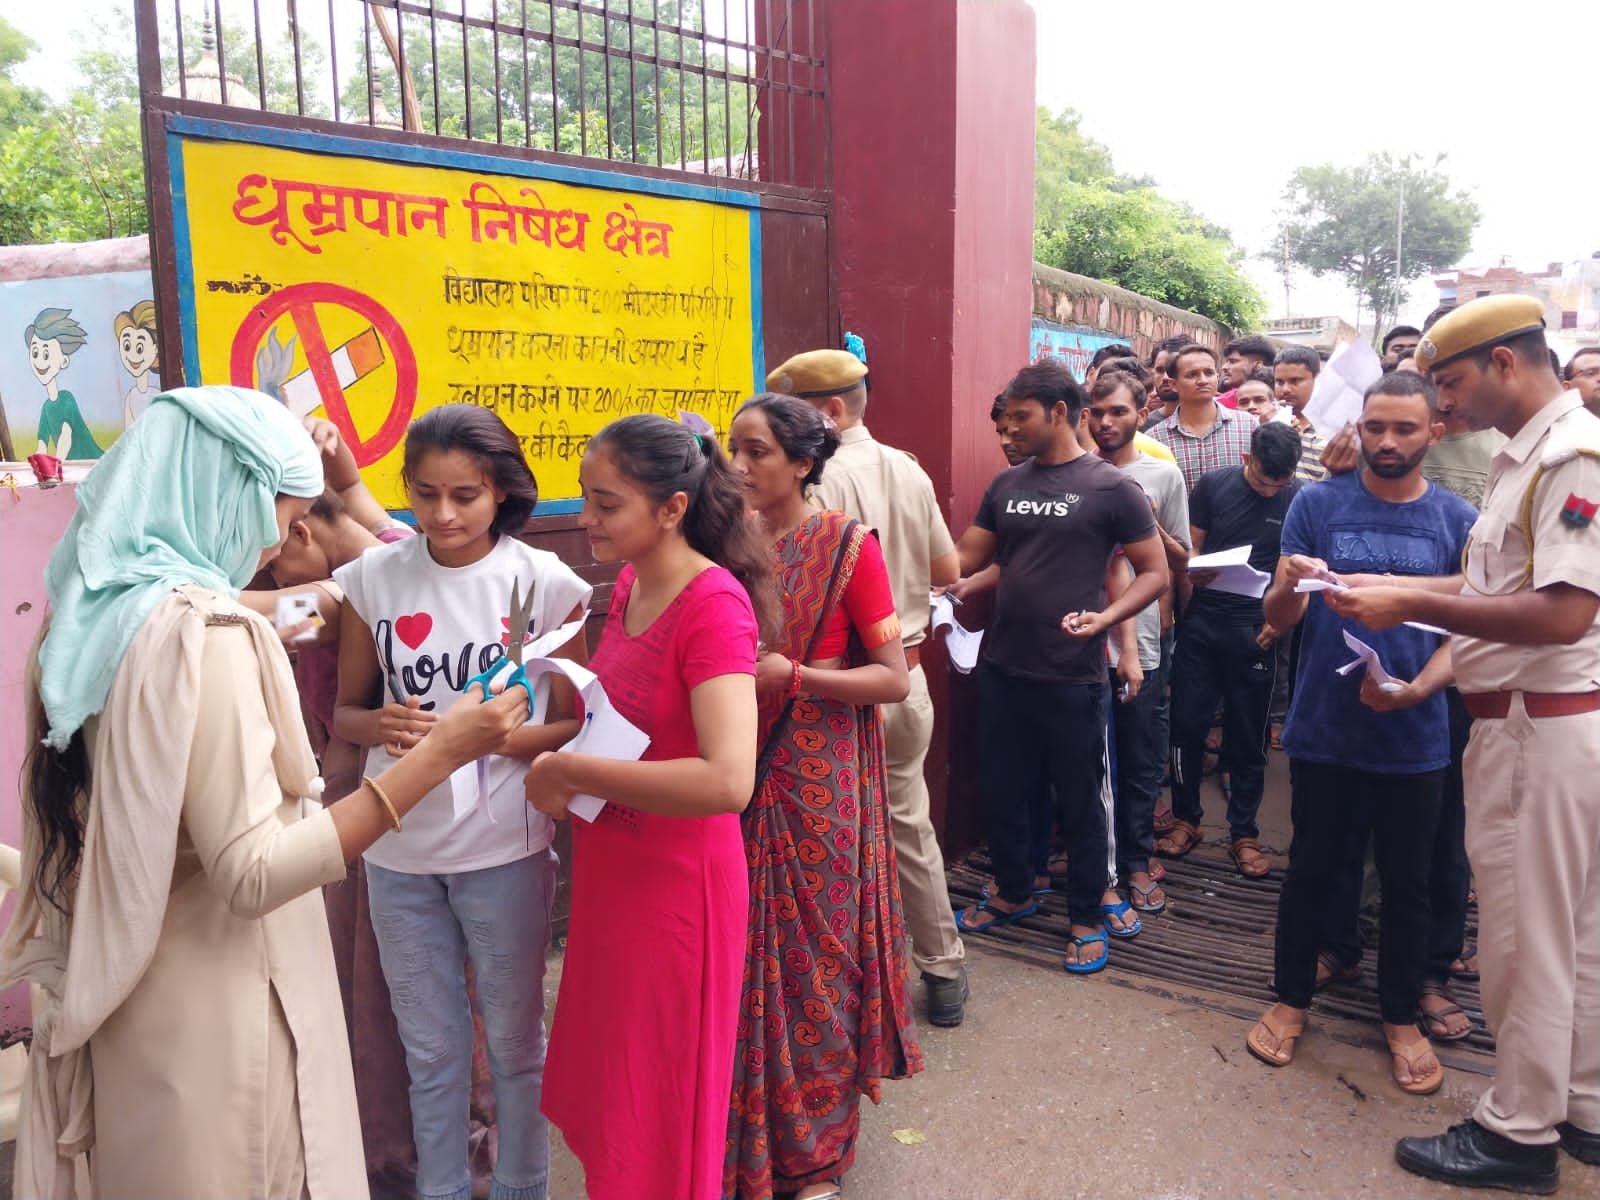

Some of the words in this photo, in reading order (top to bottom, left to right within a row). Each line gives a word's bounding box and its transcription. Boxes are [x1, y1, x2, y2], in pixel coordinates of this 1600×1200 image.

[233, 173, 449, 254] धूम्रपान
[462, 182, 591, 252] निषेध
[603, 202, 674, 258] क्षेत्र
[442, 266, 517, 308] विद्यालय
[565, 386, 592, 414] पर
